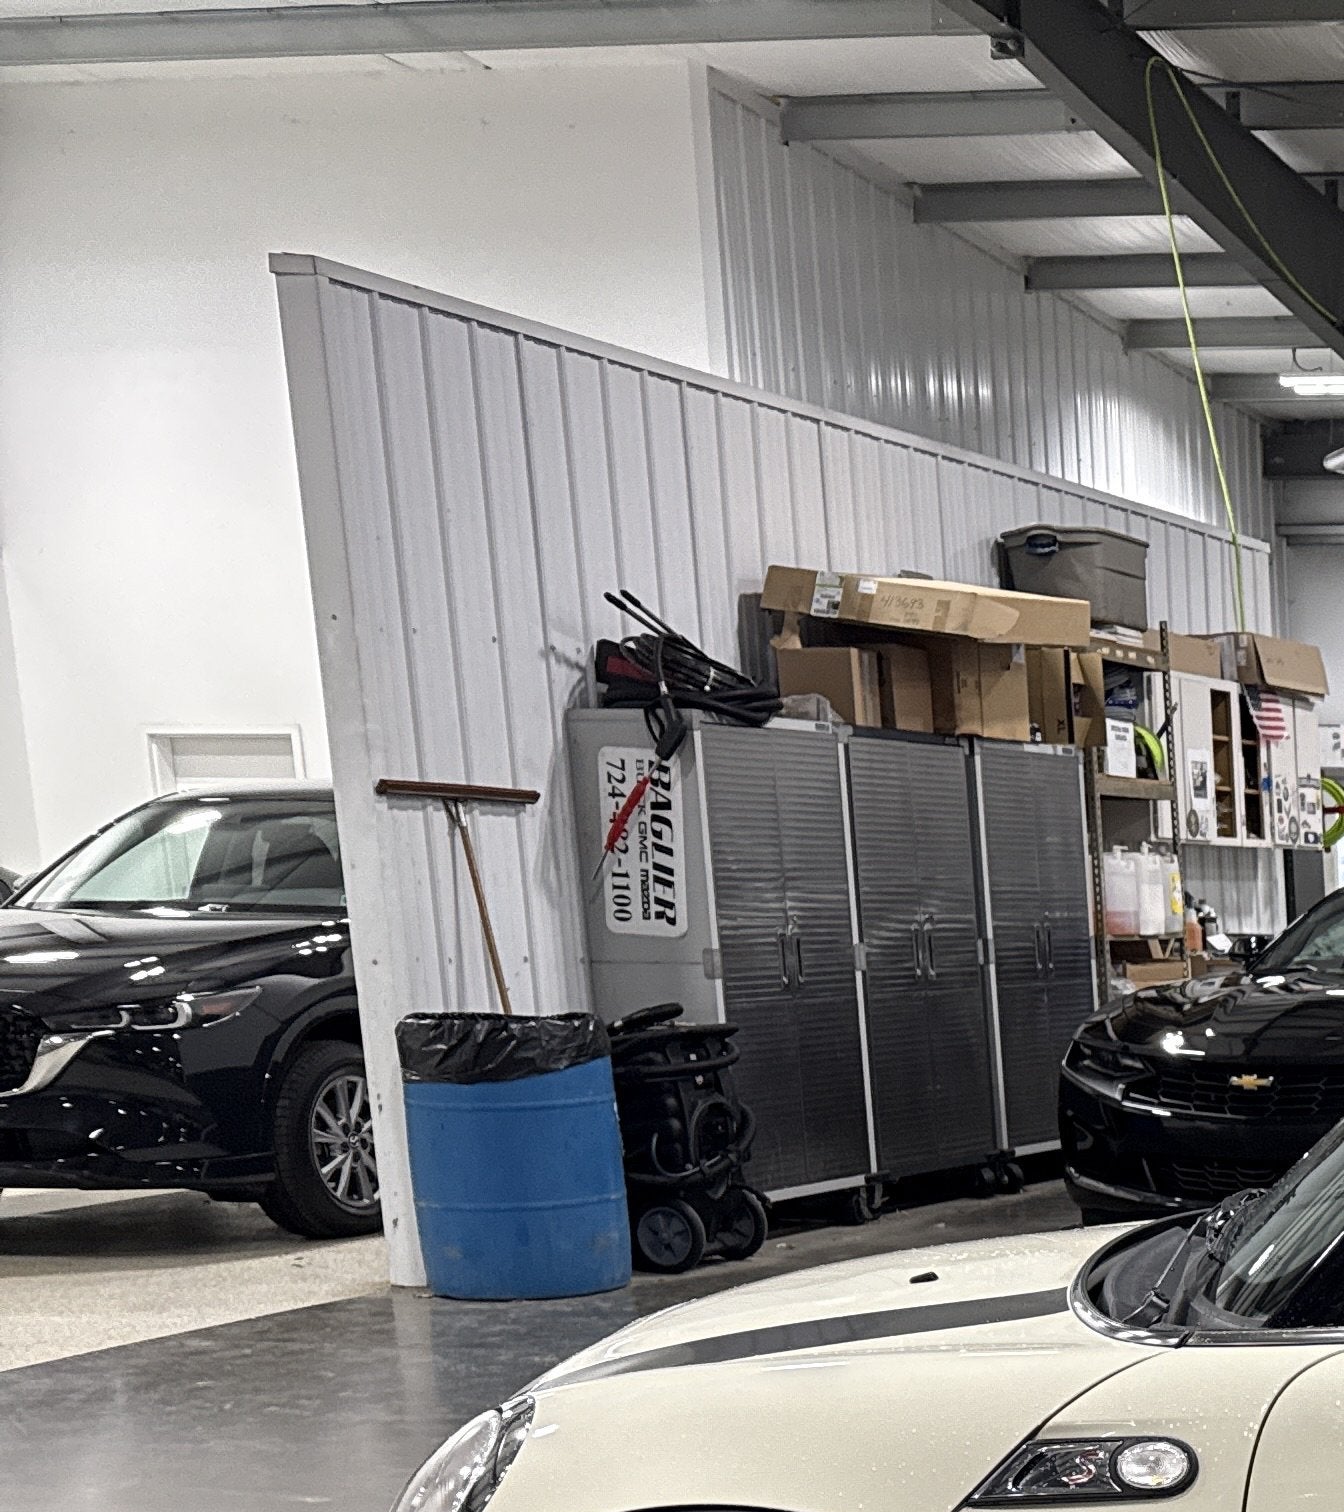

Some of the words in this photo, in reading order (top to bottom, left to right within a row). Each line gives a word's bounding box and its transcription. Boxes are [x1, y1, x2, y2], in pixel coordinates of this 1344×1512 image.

[635, 758, 647, 815] BUK
[638, 821, 649, 863] GMC
[648, 759, 677, 926] BAGLIER
